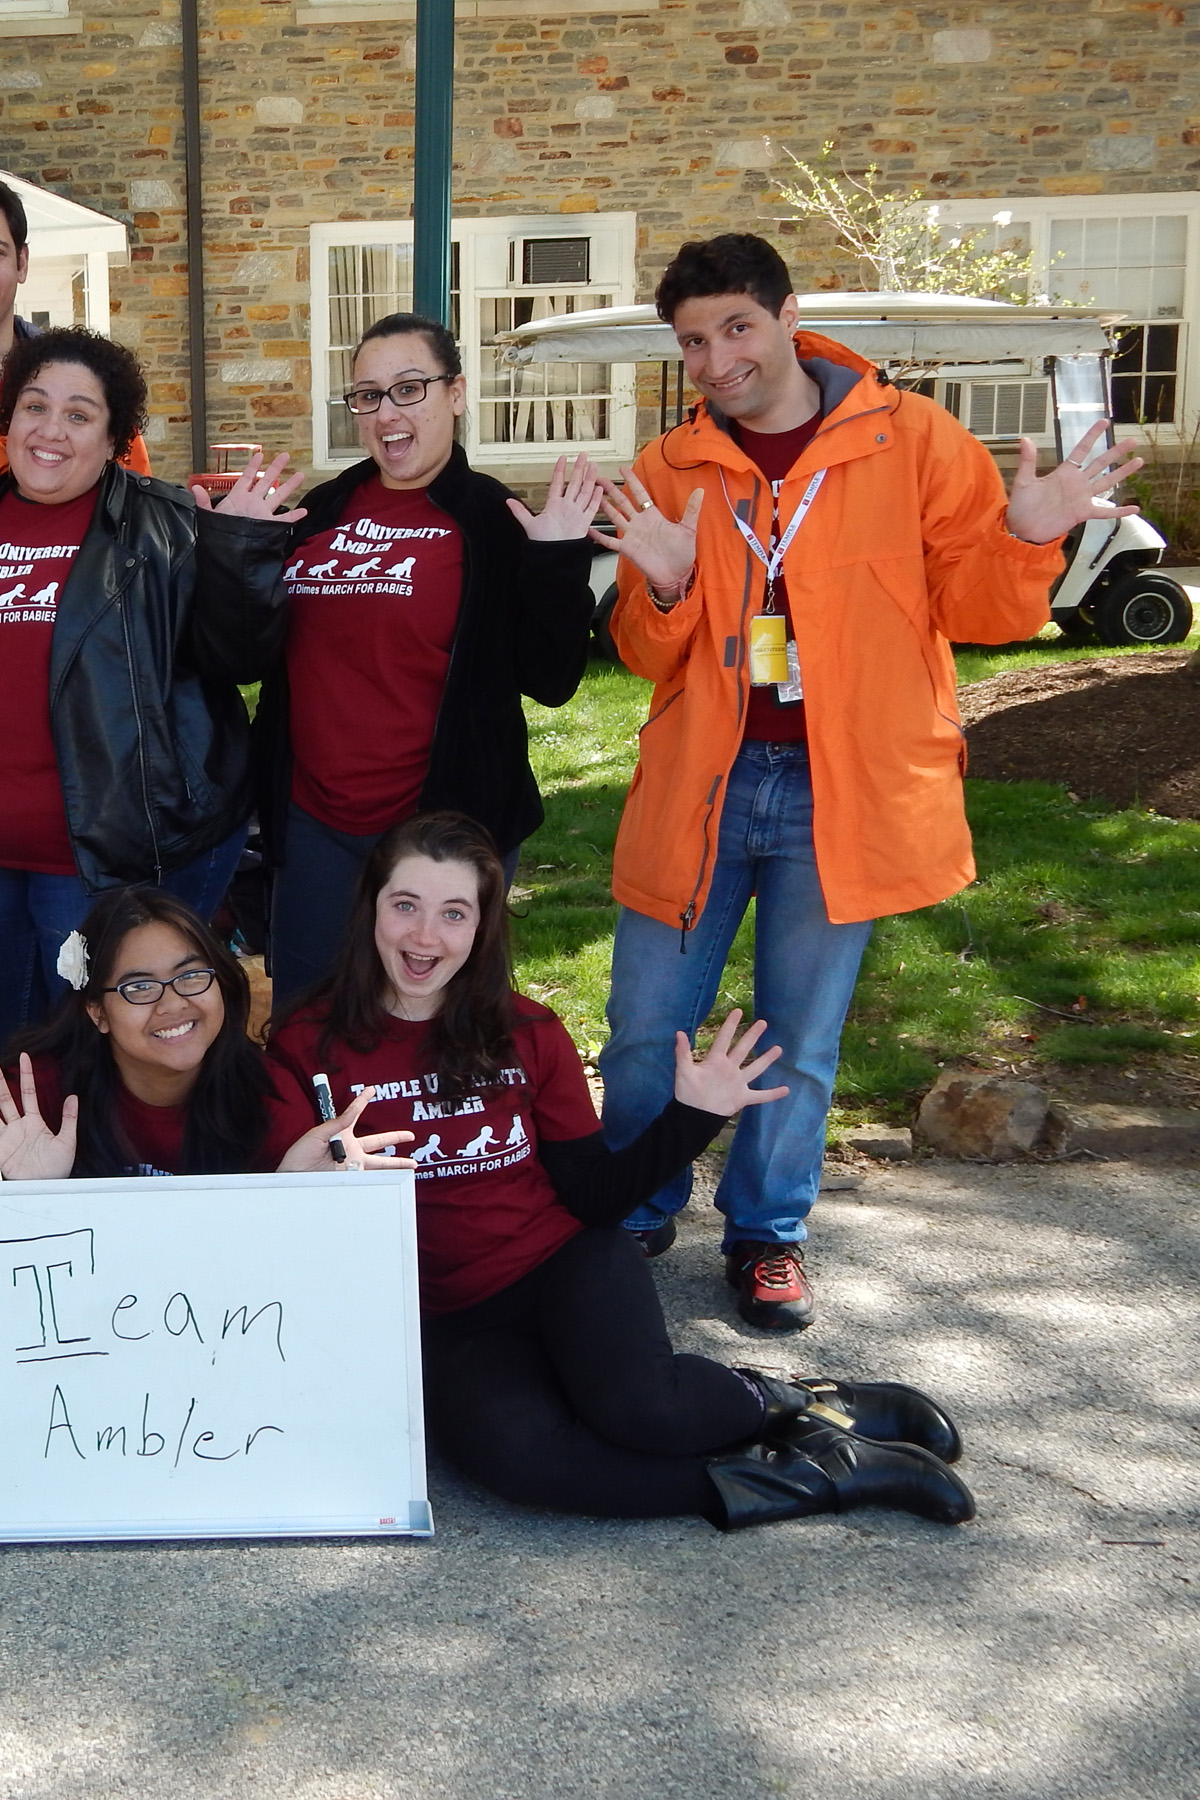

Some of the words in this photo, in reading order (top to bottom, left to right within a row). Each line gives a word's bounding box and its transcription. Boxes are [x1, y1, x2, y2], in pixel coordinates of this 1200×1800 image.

[355, 518, 452, 540] UNIVERSITY
[329, 532, 393, 555] AMBLER
[296, 583, 319, 595] Dimes
[321, 584, 353, 595] MARCH
[355, 583, 374, 594] FOR
[375, 582, 413, 596] BABIES
[3, 611, 21, 623] FOR
[22, 610, 57, 623] BABIES
[350, 1079, 422, 1103] TMPLE
[414, 1171, 435, 1180] mes
[437, 1163, 477, 1177] MARCH
[480, 1157, 502, 1172] FOR
[503, 1144, 531, 1167] BABIES
[44, 1383, 285, 1468] Ambler
